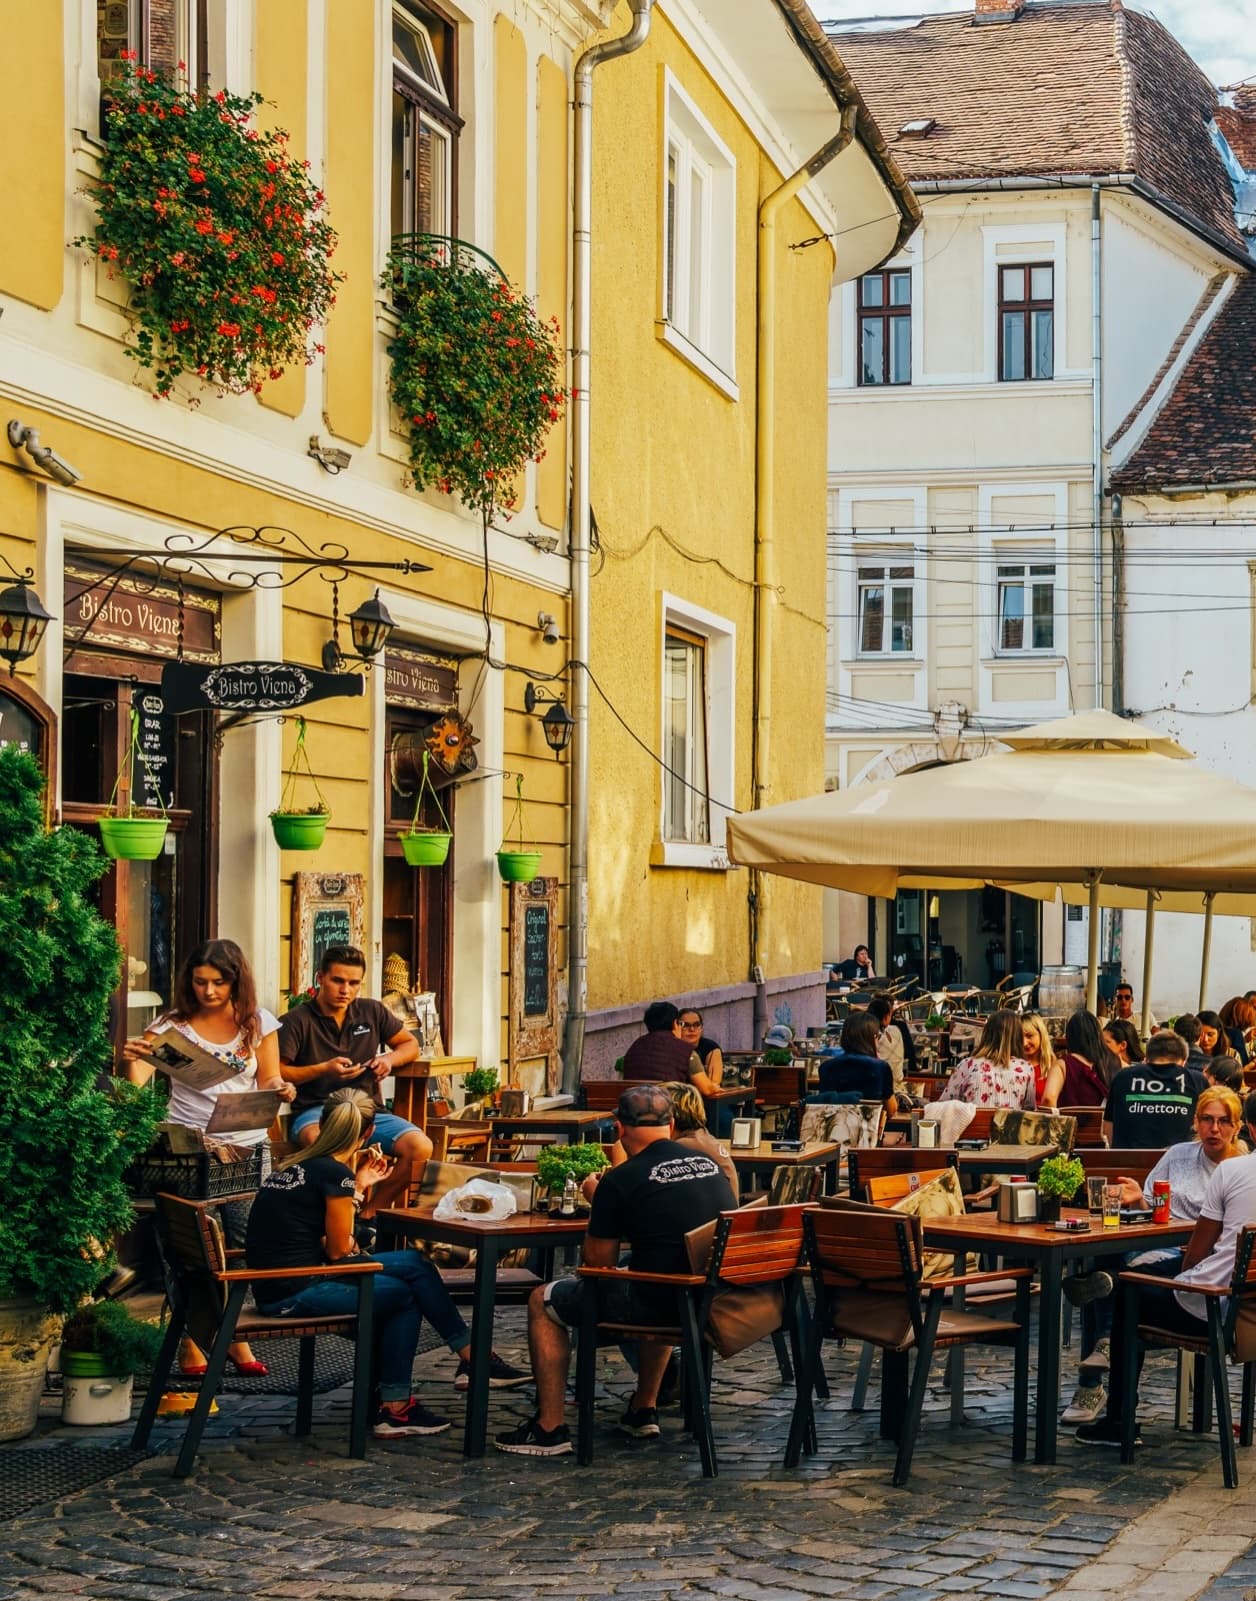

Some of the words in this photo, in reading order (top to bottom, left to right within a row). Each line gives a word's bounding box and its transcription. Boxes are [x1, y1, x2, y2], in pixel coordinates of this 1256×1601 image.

[80, 593, 132, 626] Bistro
[219, 677, 257, 698] Bistro
[261, 675, 296, 696] Viena
[387, 667, 409, 688] stro
[1131, 1077, 1171, 1093] no.
[1175, 1073, 1186, 1093] 1
[1129, 1101, 1188, 1115] direttore
[660, 1165, 692, 1178] Bistro
